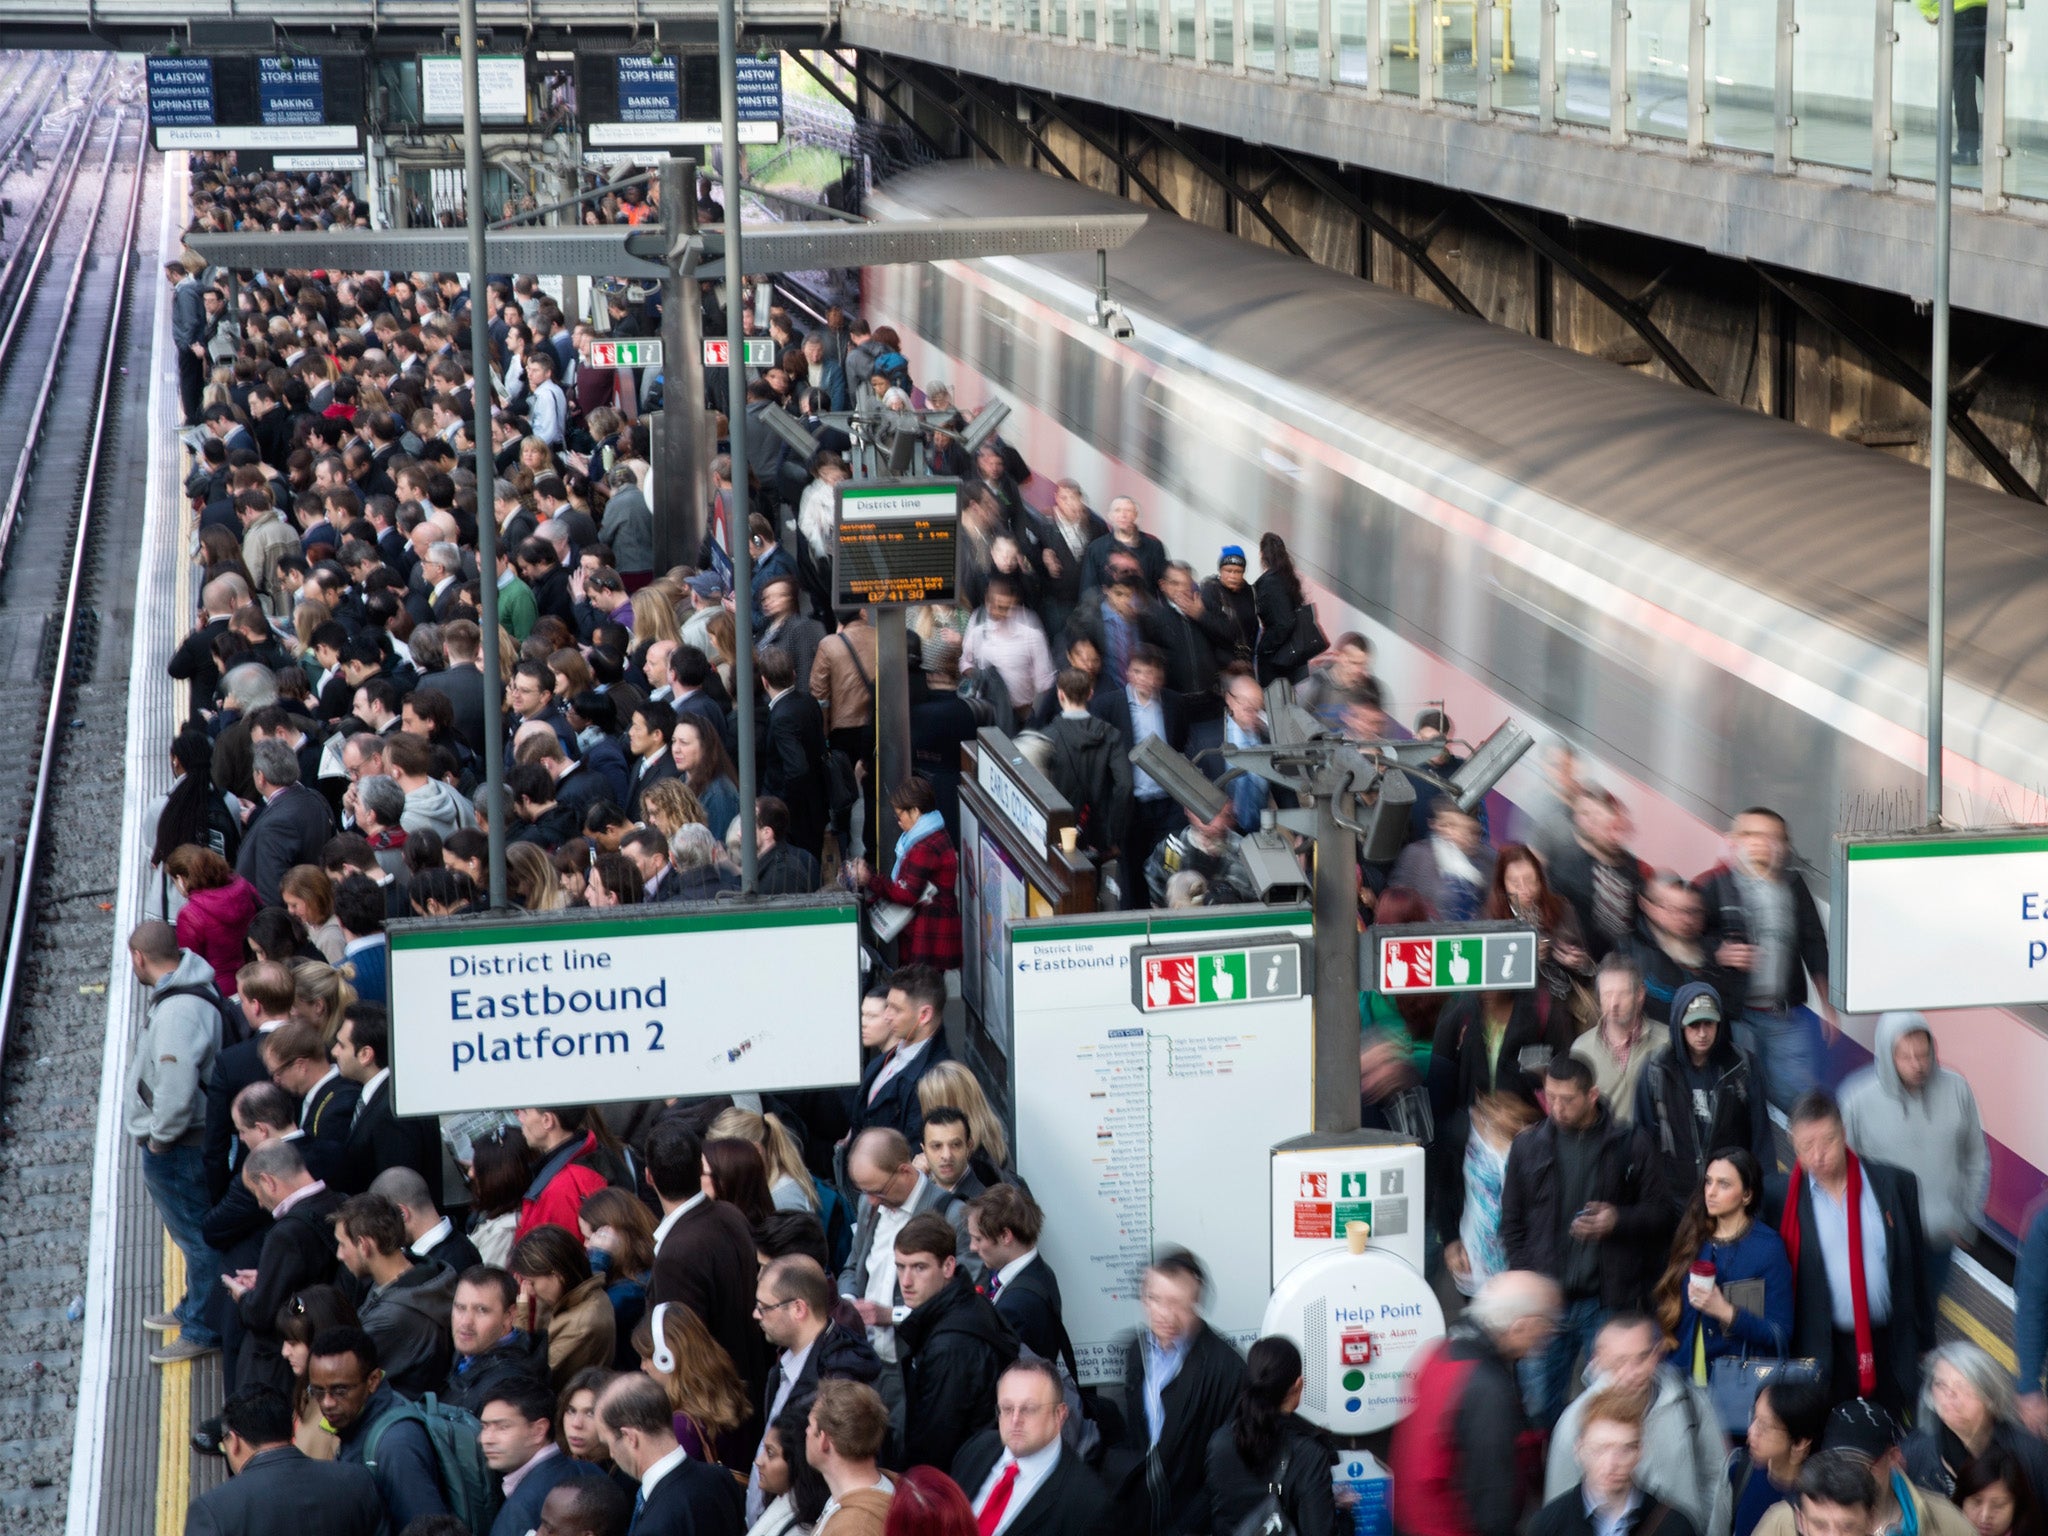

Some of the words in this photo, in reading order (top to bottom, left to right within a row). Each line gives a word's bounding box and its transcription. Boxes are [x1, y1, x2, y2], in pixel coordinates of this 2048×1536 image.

[184, 59, 208, 67] HOUSE
[260, 57, 296, 68] TOW
[297, 57, 318, 68] HILL
[619, 57, 652, 67] TOWER
[153, 72, 206, 83] PLAISTOW
[261, 71, 293, 82] STOPS
[294, 71, 320, 81] HERE
[620, 71, 649, 80] STOPS
[651, 71, 675, 80] HERE
[736, 70, 775, 80] AISTOW
[192, 87, 210, 95] EAST
[152, 100, 211, 110] UPMINSTER
[270, 98, 314, 109] BARKING
[628, 97, 669, 107] BARKING
[737, 96, 778, 106] MINSTER
[170, 131, 213, 139] Platform
[291, 158, 334, 167] Piccadilly
[338, 158, 354, 166] line
[857, 499, 898, 510] District
[900, 498, 921, 508] line
[1033, 944, 1071, 955] District
[1075, 943, 1094, 952] line
[450, 952, 553, 978] District
[564, 949, 612, 970] line
[1033, 954, 1114, 971] Eastbound
[451, 976, 667, 1021] Eastbound
[452, 1026, 630, 1073] platform
[645, 1019, 665, 1051] 2
[1335, 1307, 1375, 1322] Help
[1381, 1303, 1423, 1318] Point
[1390, 1328, 1417, 1337] Alarm
[1092, 1346, 1103, 1354] to
[1239, 1332, 1257, 1341] and
[1369, 1370, 1418, 1380] Emergency
